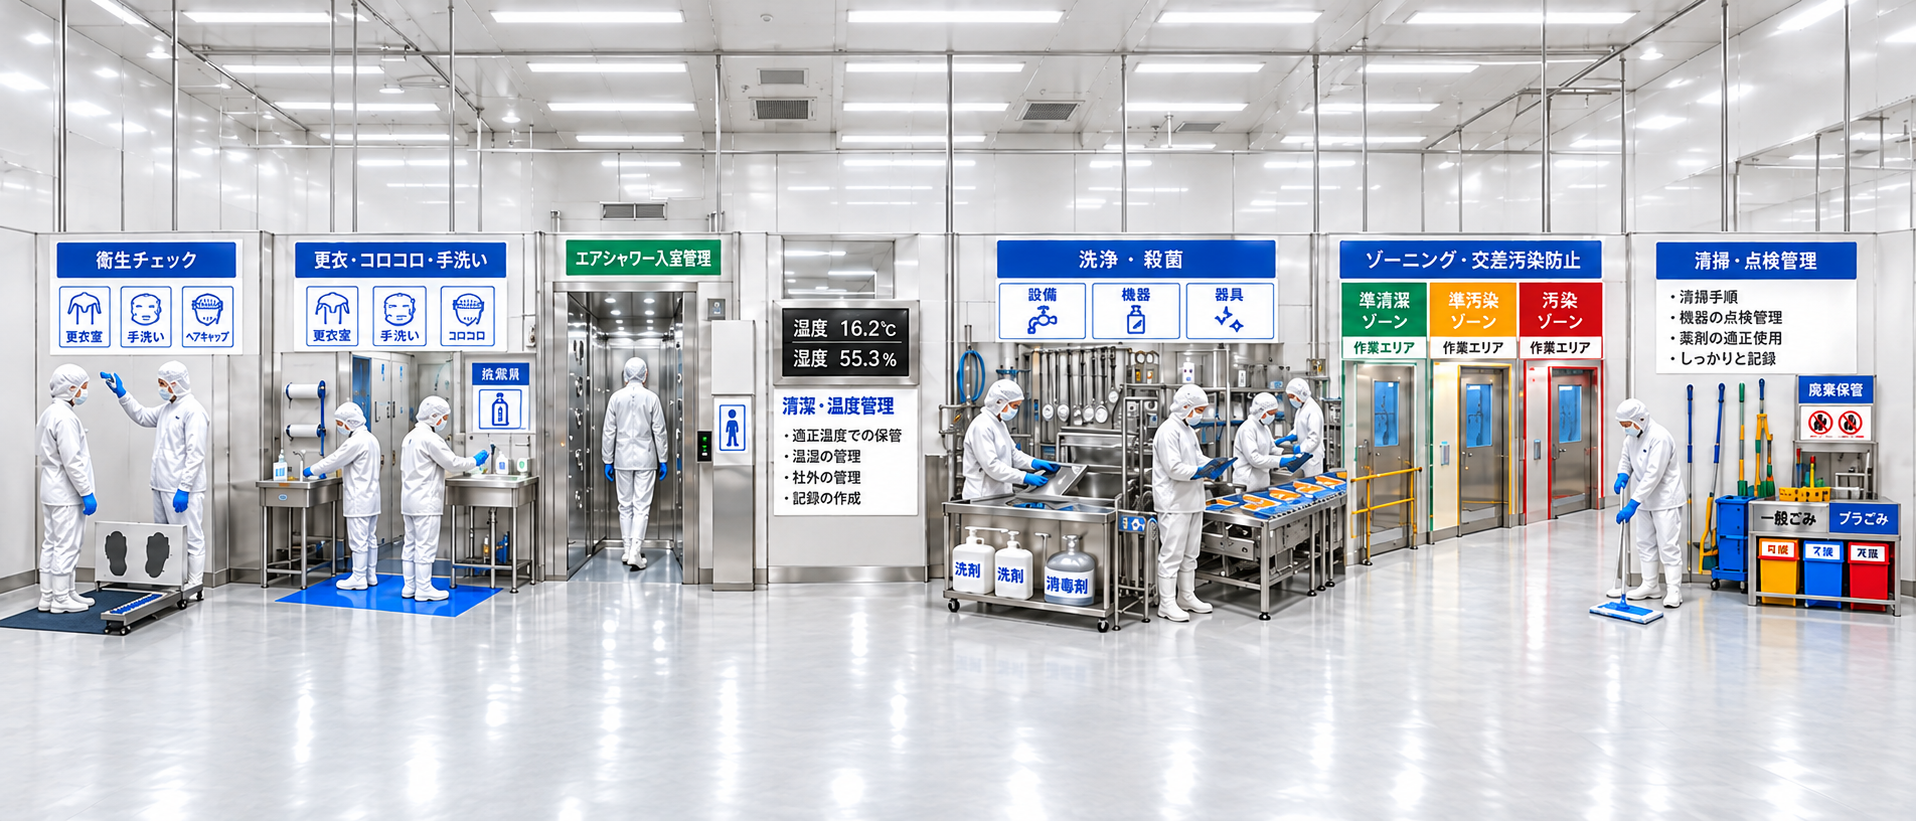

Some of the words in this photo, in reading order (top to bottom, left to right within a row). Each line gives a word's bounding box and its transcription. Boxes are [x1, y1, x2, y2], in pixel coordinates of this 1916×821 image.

[96, 251, 196, 269] 衛生チェック
[315, 250, 487, 269] 更衣・コロコロ・手洗い
[576, 249, 711, 267] エアシャワー入室管理
[1367, 250, 1580, 269] ゾーニング・交差汚染防止
[1695, 251, 1817, 270] 清掃・点検管理
[1028, 288, 1057, 302] 設備
[1122, 288, 1151, 302] 機器
[1215, 288, 1243, 301] 器具
[1449, 292, 1498, 309] 準汚染
[1543, 292, 1577, 309] 汚染
[794, 319, 827, 337] 温度
[1363, 313, 1407, 329] ゾーン
[1452, 313, 1496, 329] ゾーン
[1538, 313, 1582, 329] ゾーン
[66, 331, 103, 343] 更衣室
[128, 331, 164, 343] 手洗い
[313, 329, 350, 341] 更衣室
[381, 330, 419, 341] 手洗い
[1354, 341, 1415, 354] 作業エリア
[1443, 341, 1503, 354] 作業エリア
[1530, 341, 1590, 354] 作業エリア
[794, 349, 827, 367] 湿度
[840, 350, 896, 366] 55.3%
[783, 396, 894, 415] 清潔・温度管理
[955, 562, 980, 578] 洗剤
[998, 567, 1023, 583] 洗剤
